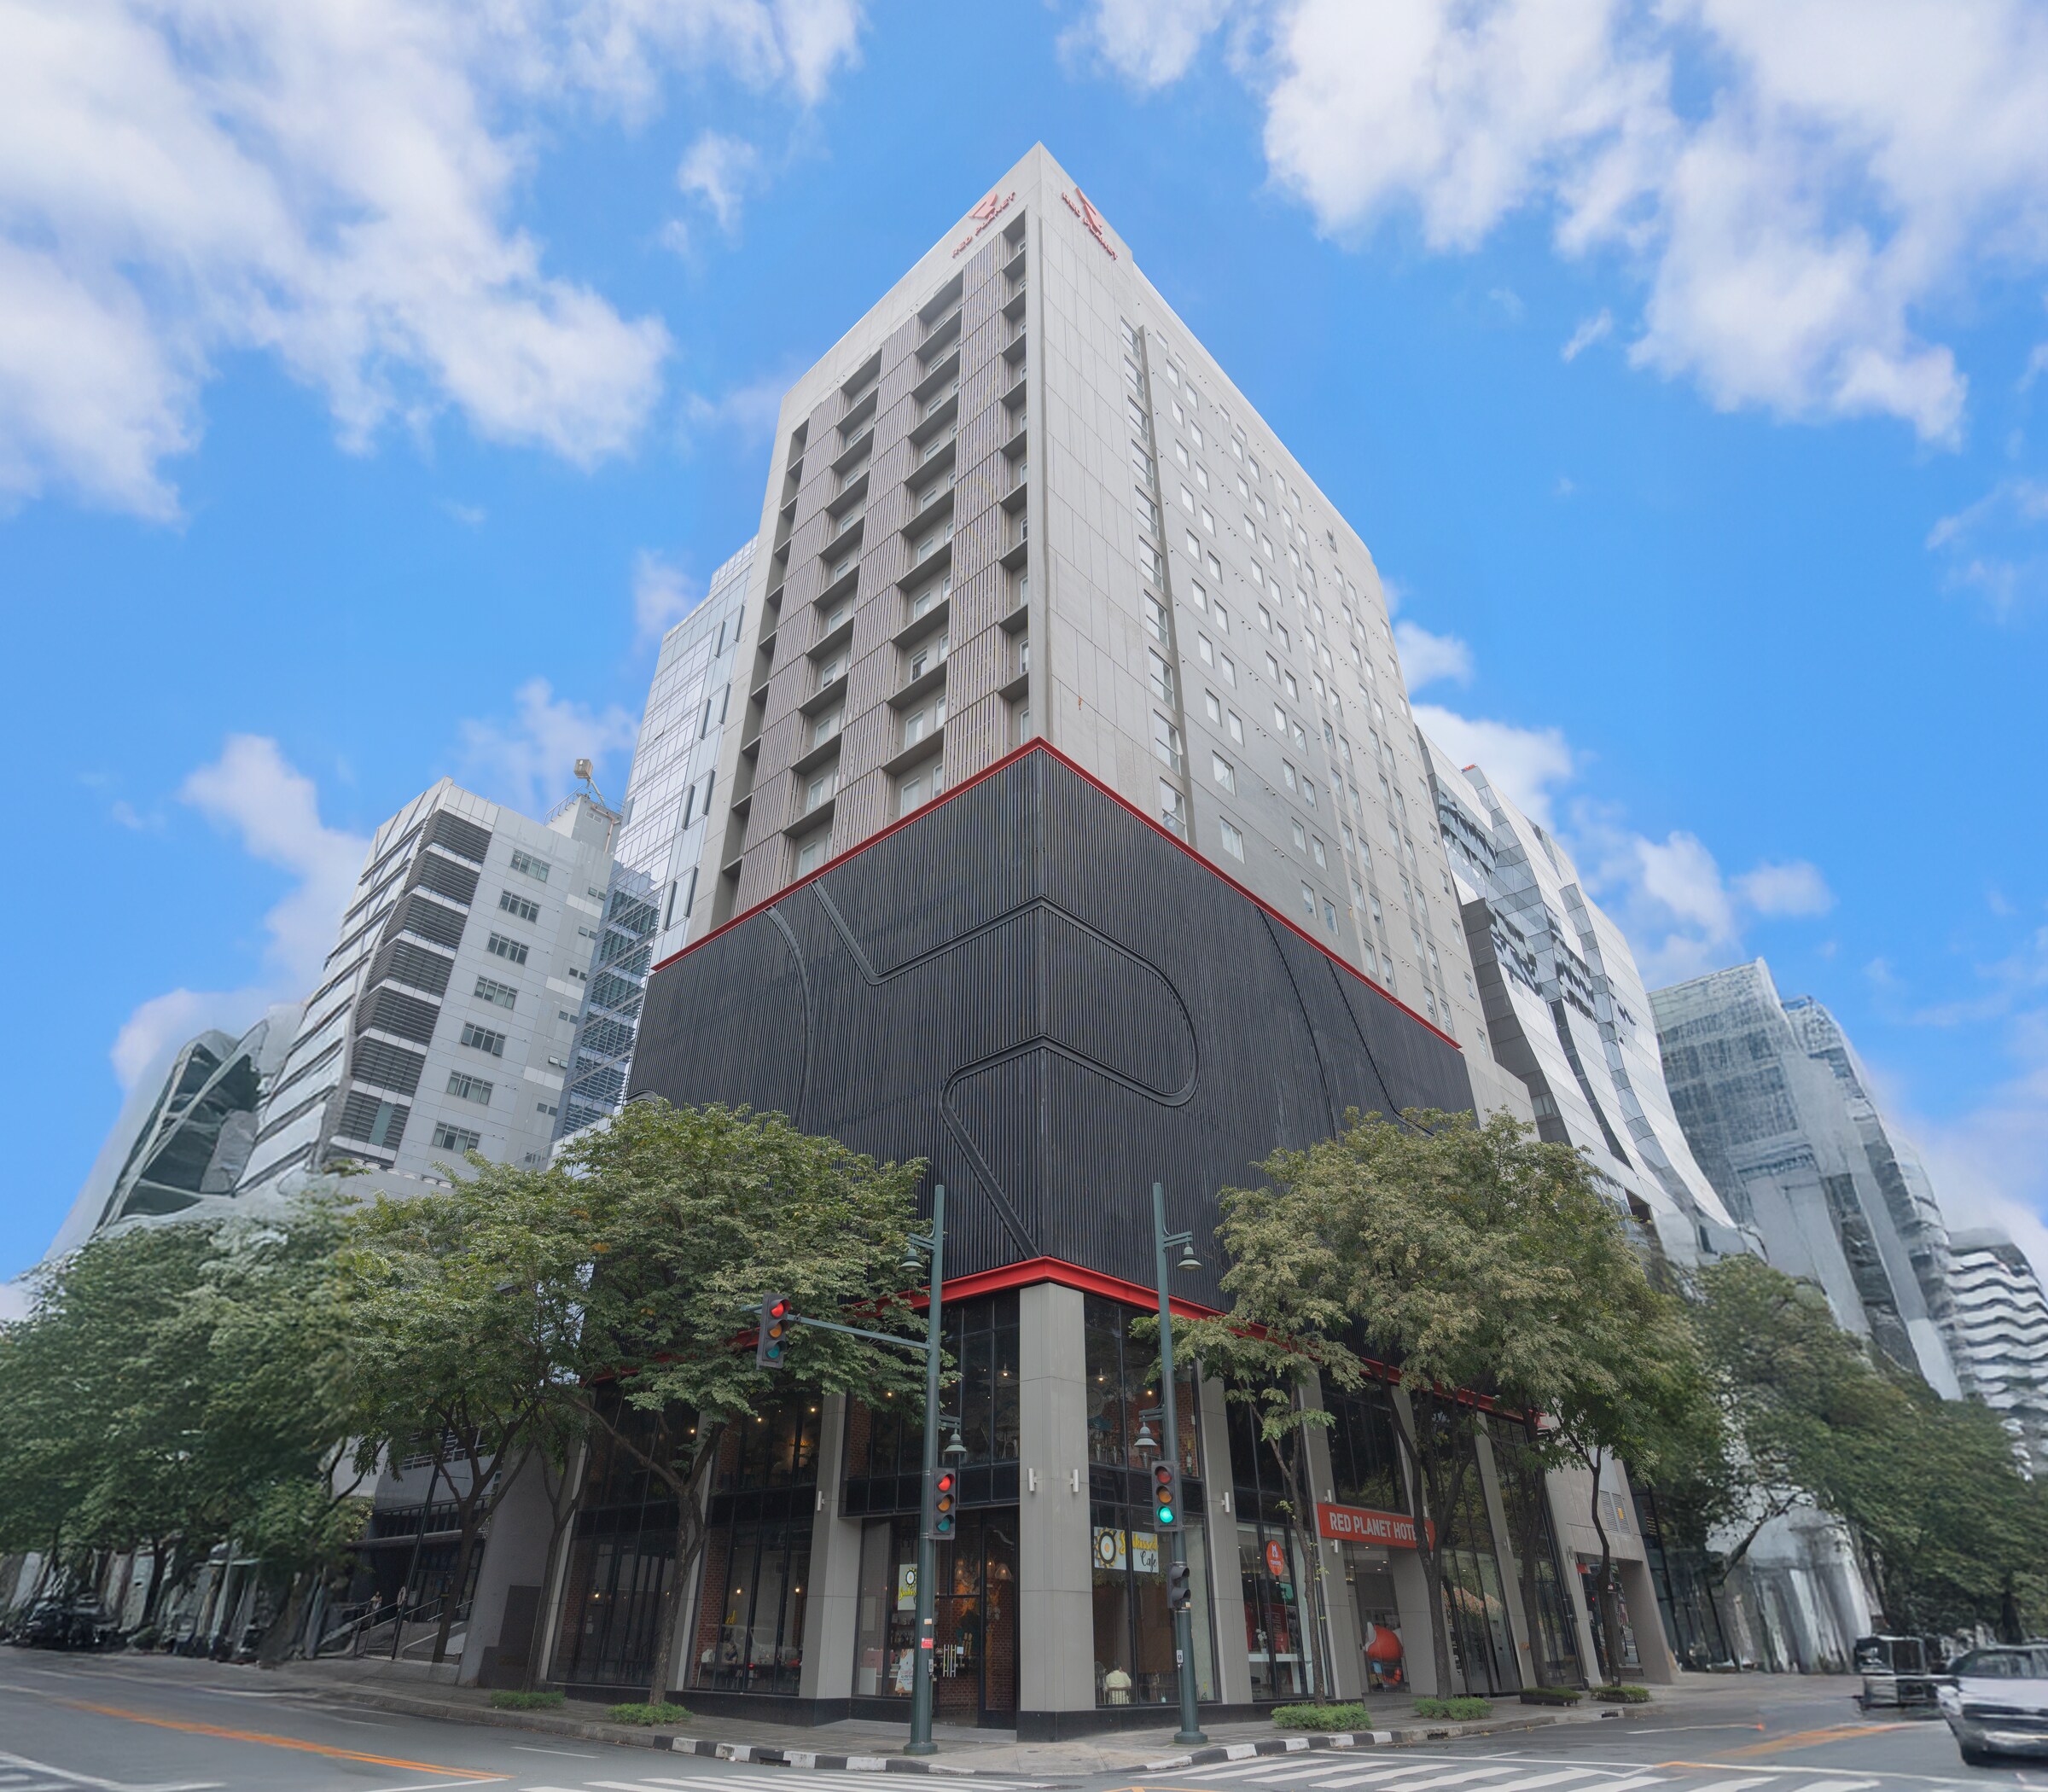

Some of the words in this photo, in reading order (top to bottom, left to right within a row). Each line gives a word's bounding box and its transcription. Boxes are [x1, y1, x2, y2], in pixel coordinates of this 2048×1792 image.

[1062, 191, 1081, 218] RED
[951, 235, 973, 259] RED
[975, 191, 1015, 236] PLANET
[1329, 1512, 1352, 1532] RED
[1353, 1516, 1391, 1538] PLANET
[1393, 1521, 1428, 1542] HOT
[1140, 1551, 1157, 1573] Cafe
